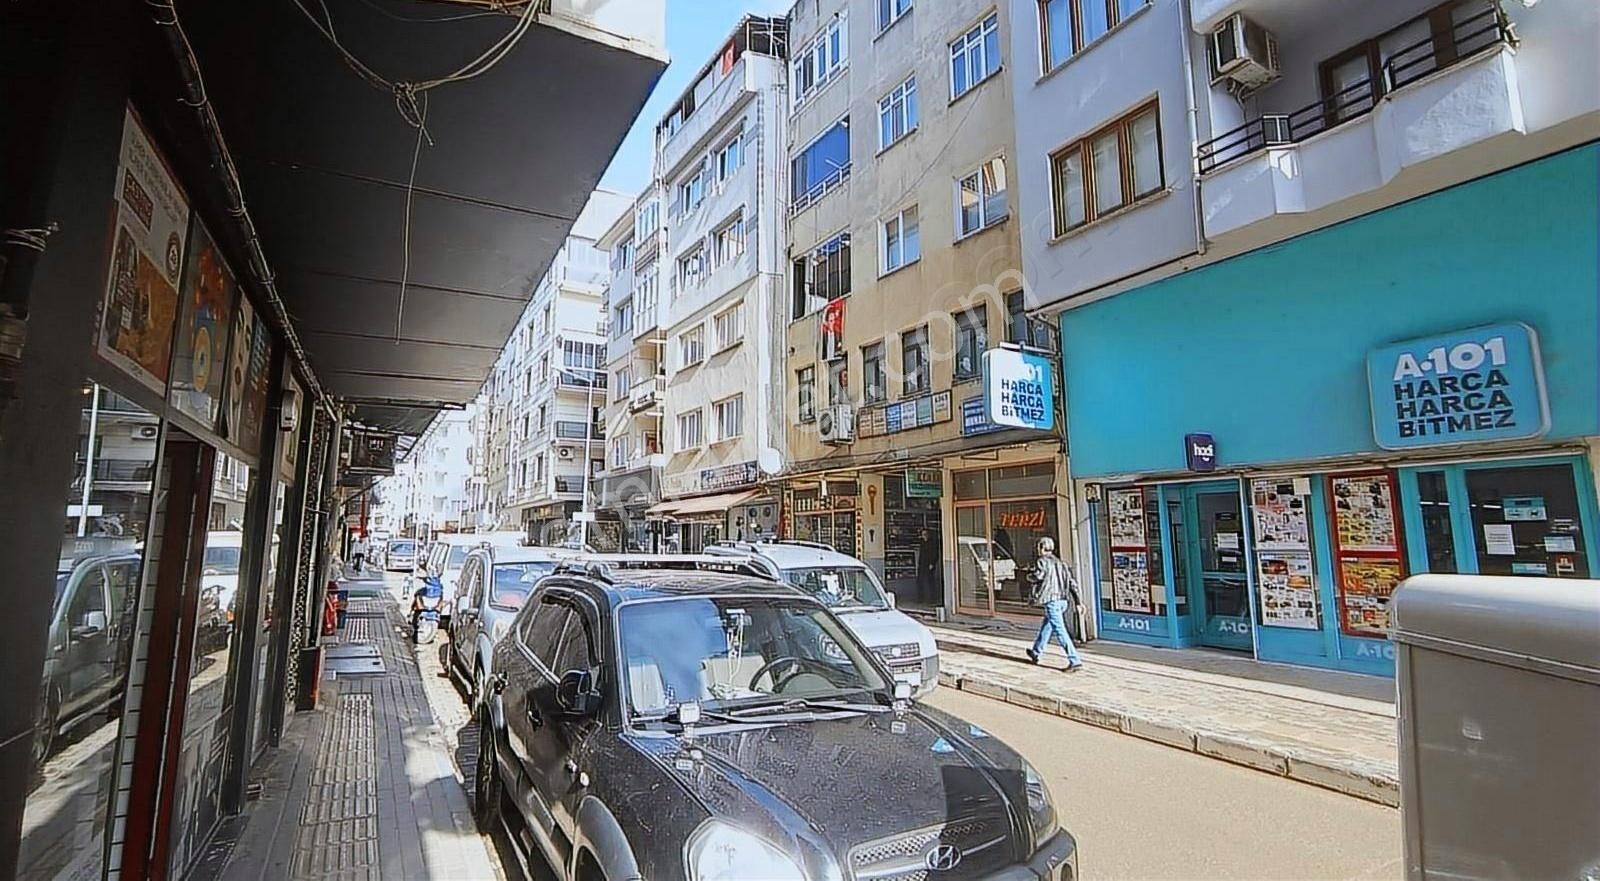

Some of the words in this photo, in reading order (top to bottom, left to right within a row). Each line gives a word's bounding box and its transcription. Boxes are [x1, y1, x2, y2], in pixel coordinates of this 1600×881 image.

[1001, 379, 1043, 396] HARCA
[1393, 369, 1509, 401] HARCA
[1001, 392, 1044, 409] HARCA
[1396, 389, 1513, 419] HARCA
